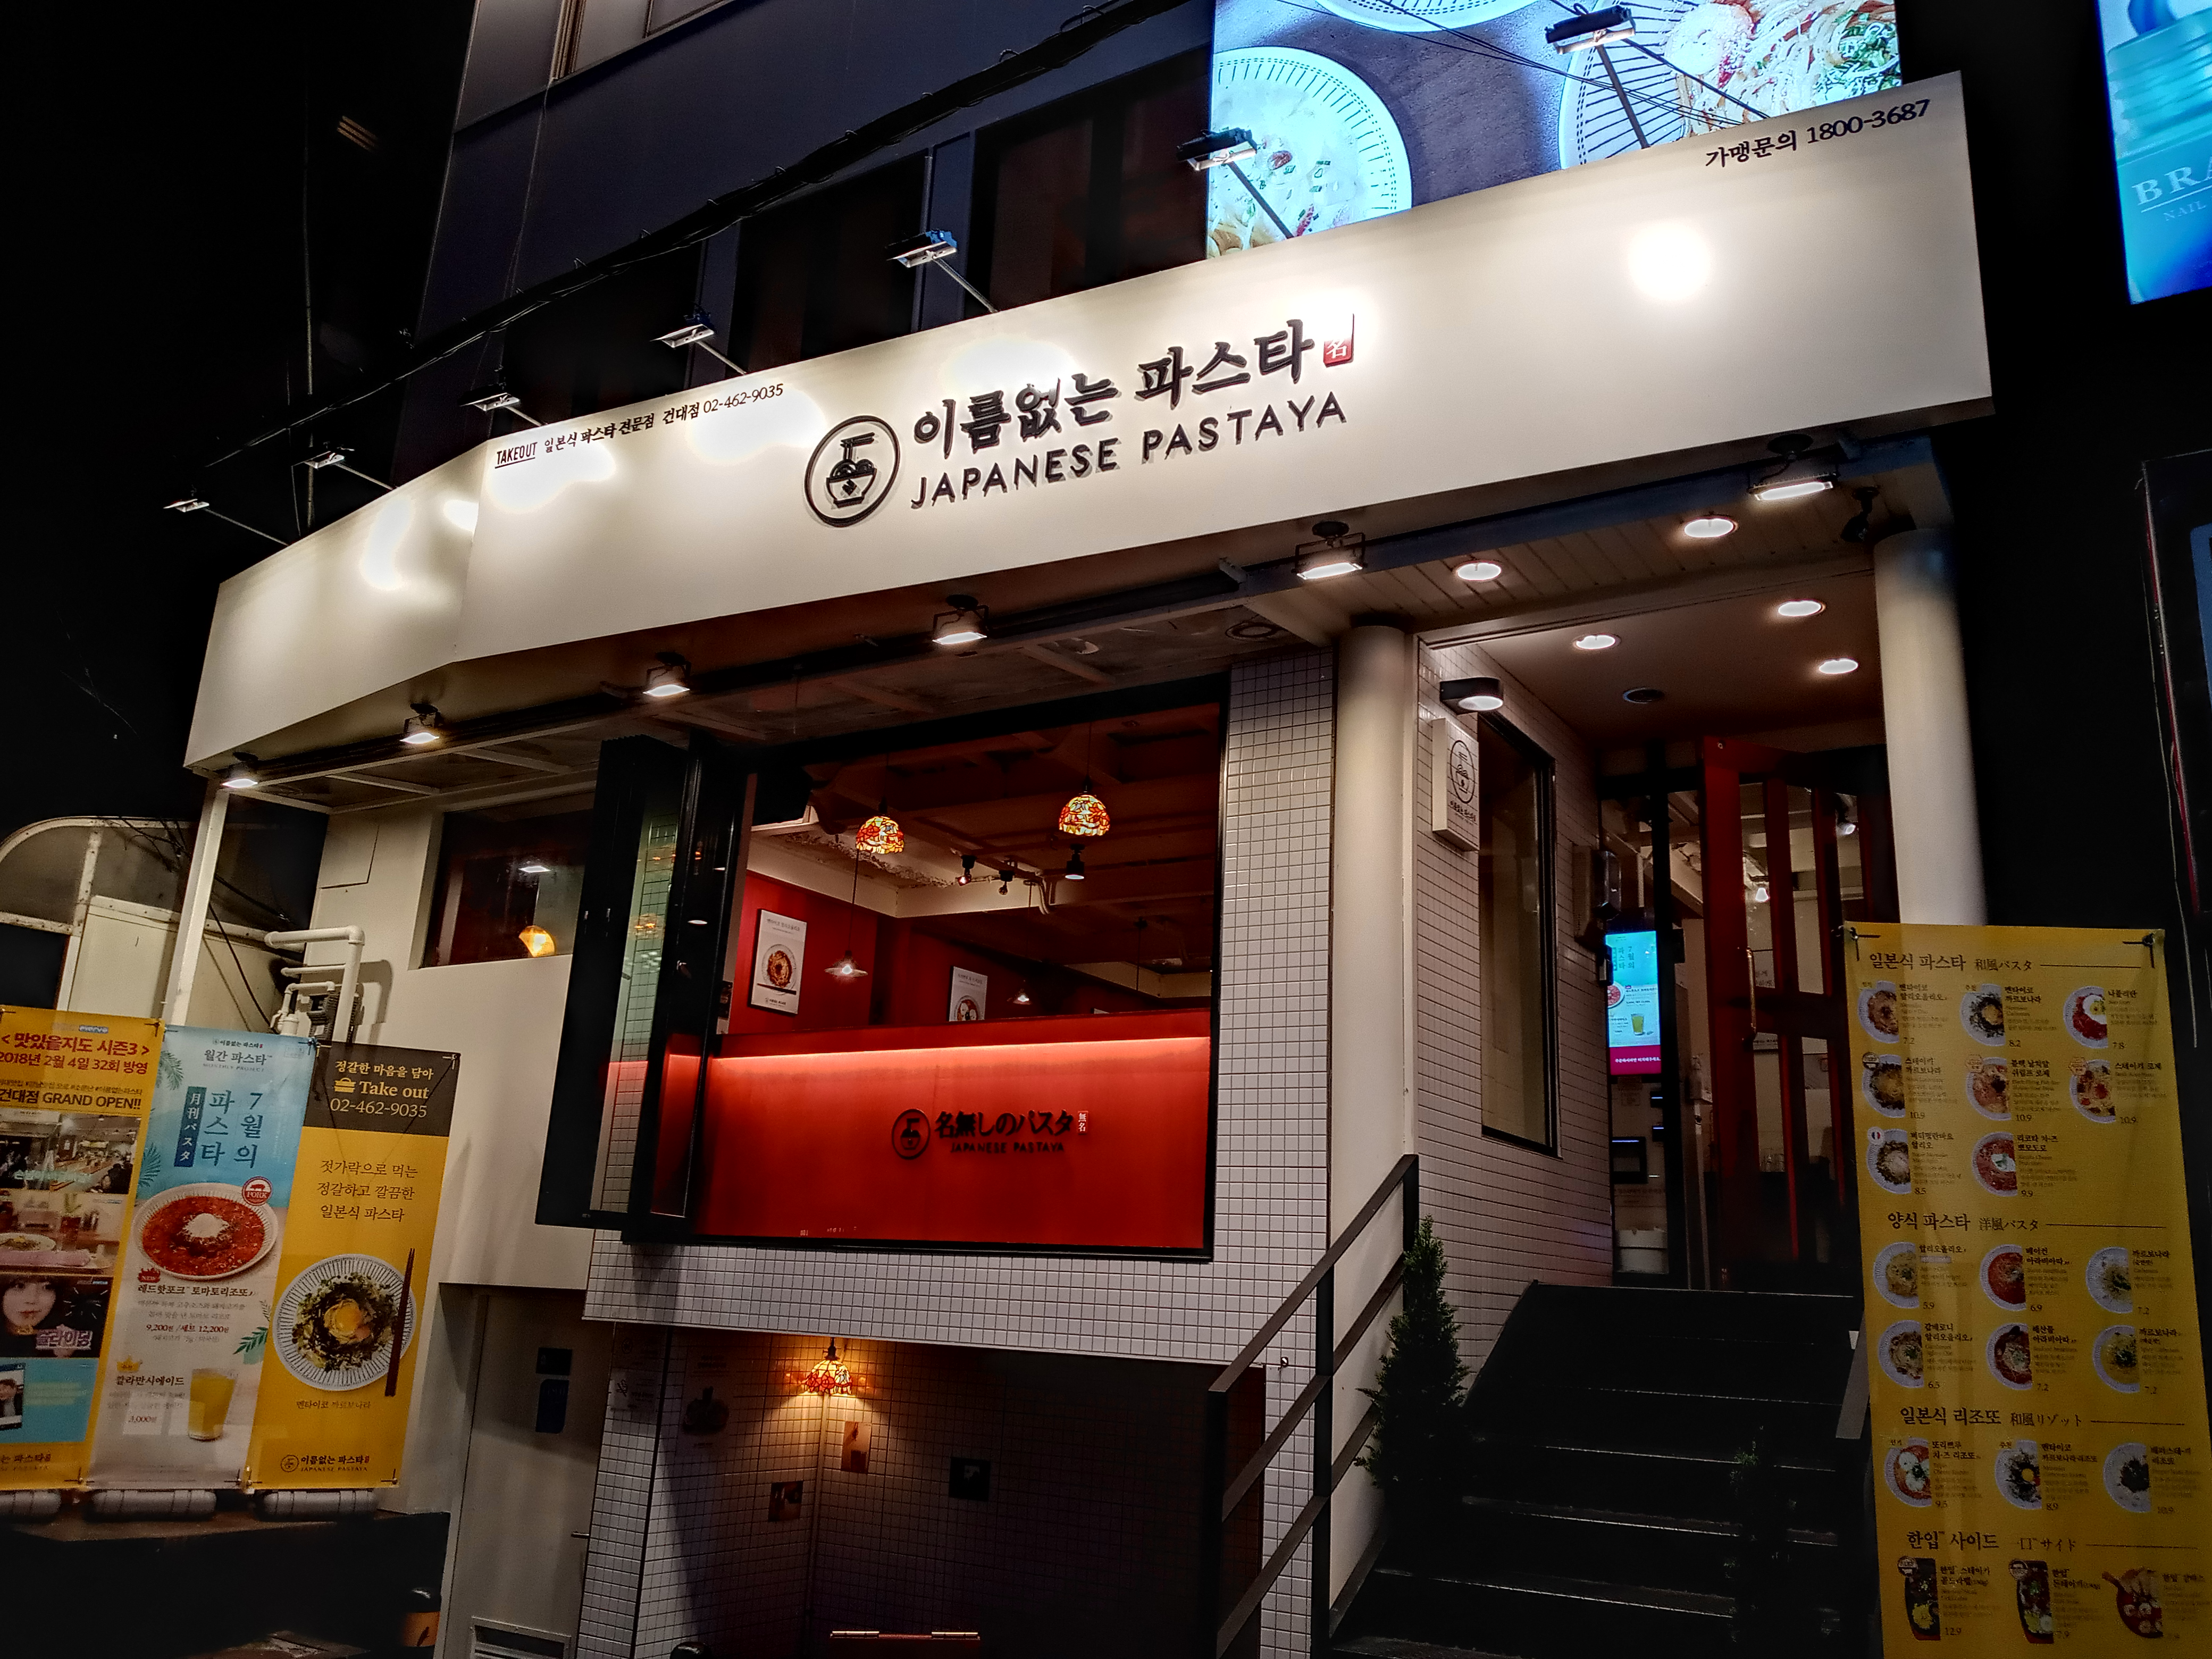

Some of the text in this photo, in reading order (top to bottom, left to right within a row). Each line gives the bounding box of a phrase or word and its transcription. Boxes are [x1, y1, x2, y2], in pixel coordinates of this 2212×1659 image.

[1705, 99, 1931, 167] 가맹문의 1800-3687
[2163, 200, 2207, 222] NAIL
[911, 318, 1316, 459] 이름없는 파스타
[496, 383, 784, 465] TAKEOUT 일본식 파스타 전문점 건대점 02-462-9035
[910, 391, 1347, 509] JAPANESE PASTAYA
[1869, 952, 2032, 971] 일본식 파스타 和風パスタ
[14, 1033, 138, 1057] 맛있을지도 시즌3
[0, 1052, 148, 1075] 2018년 2월 4일 32회 방영
[204, 1049, 267, 1066] 월간 파스타
[334, 1060, 434, 1080] 정갈한 마음을 담아
[0, 1088, 141, 1110] 건대점 GRAND OPEN!!
[358, 1080, 430, 1100] Take out
[330, 1097, 428, 1118] 02-462-9035
[179, 1093, 201, 1161] 月刊パスタ
[934, 1109, 1074, 1138] 名無しのパスタ
[950, 1141, 1065, 1153] JAPANESE PASTAYA
[320, 1159, 418, 1179] 젓가락으로 먹는
[317, 1182, 415, 1201] 정갈하고 깔끔한
[320, 1204, 405, 1222] 일본식 파스타
[1888, 1211, 1918, 1230] 양식
[1923, 1212, 1971, 1231] 파스타
[1900, 1406, 1947, 1426] 일본식
[1953, 1406, 2001, 1426] 리조또
[300, 1454, 365, 1465] 이름없는 파스타
[1906, 1530, 1940, 1551] 한입
[1950, 1531, 1999, 1551] 사이드
